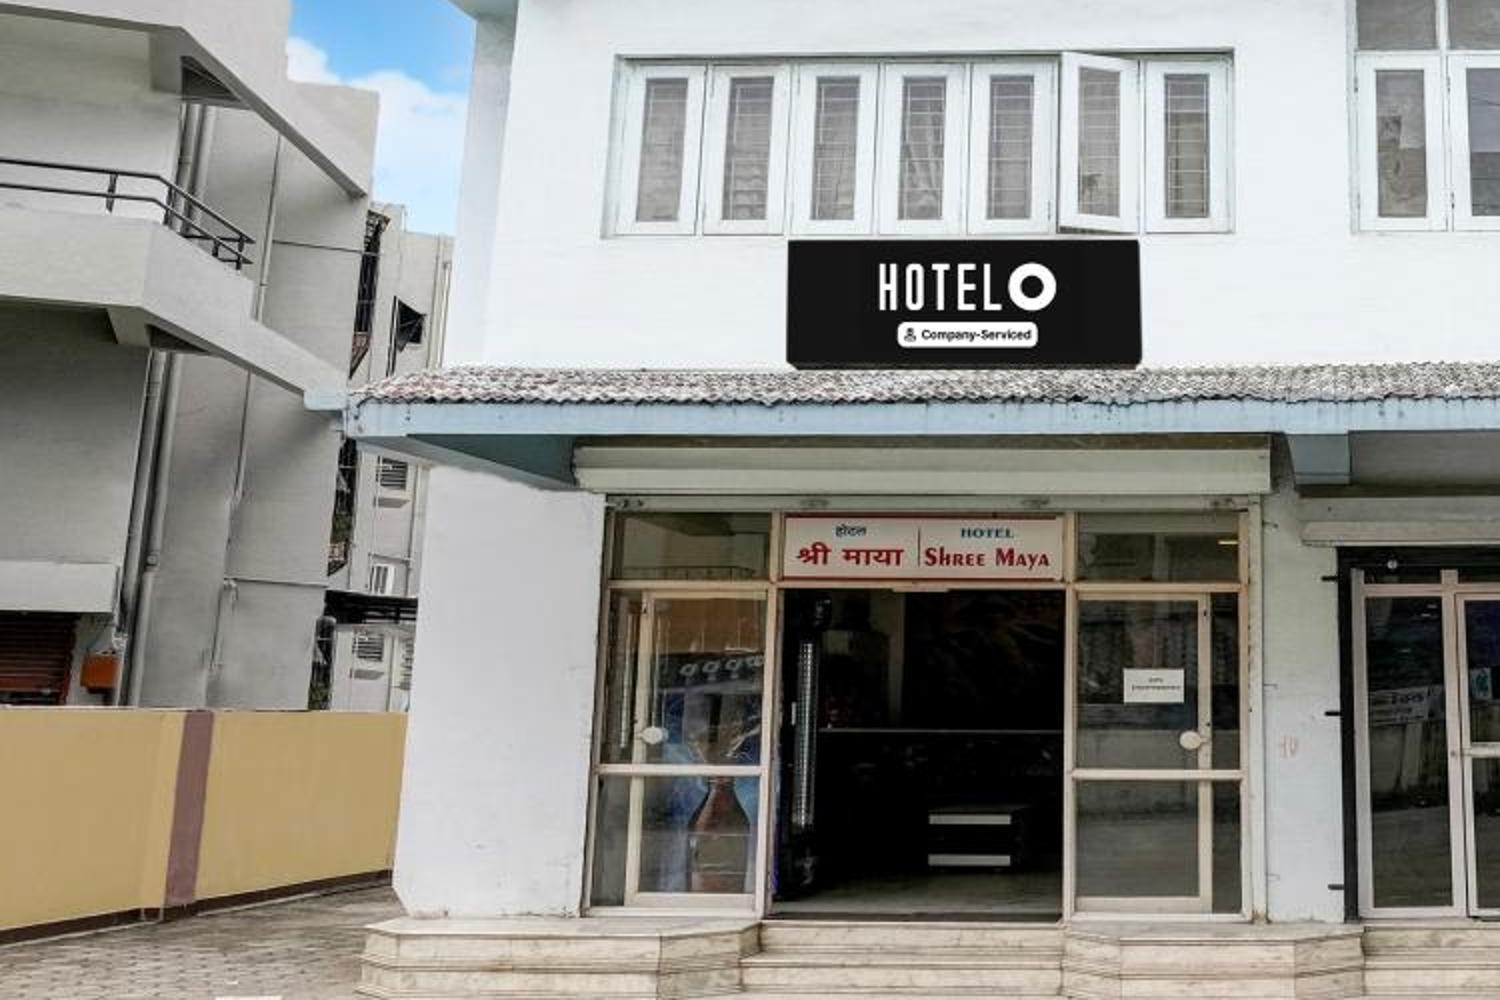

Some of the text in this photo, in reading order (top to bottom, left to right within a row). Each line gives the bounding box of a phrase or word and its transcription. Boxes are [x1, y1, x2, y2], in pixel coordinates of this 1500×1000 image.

[879, 263, 1002, 311] HOTEL
[921, 329, 1032, 343] Company-Serviced
[835, 524, 867, 537] होटल
[961, 527, 1014, 538] HOTEL
[796, 541, 904, 566] श्री माया
